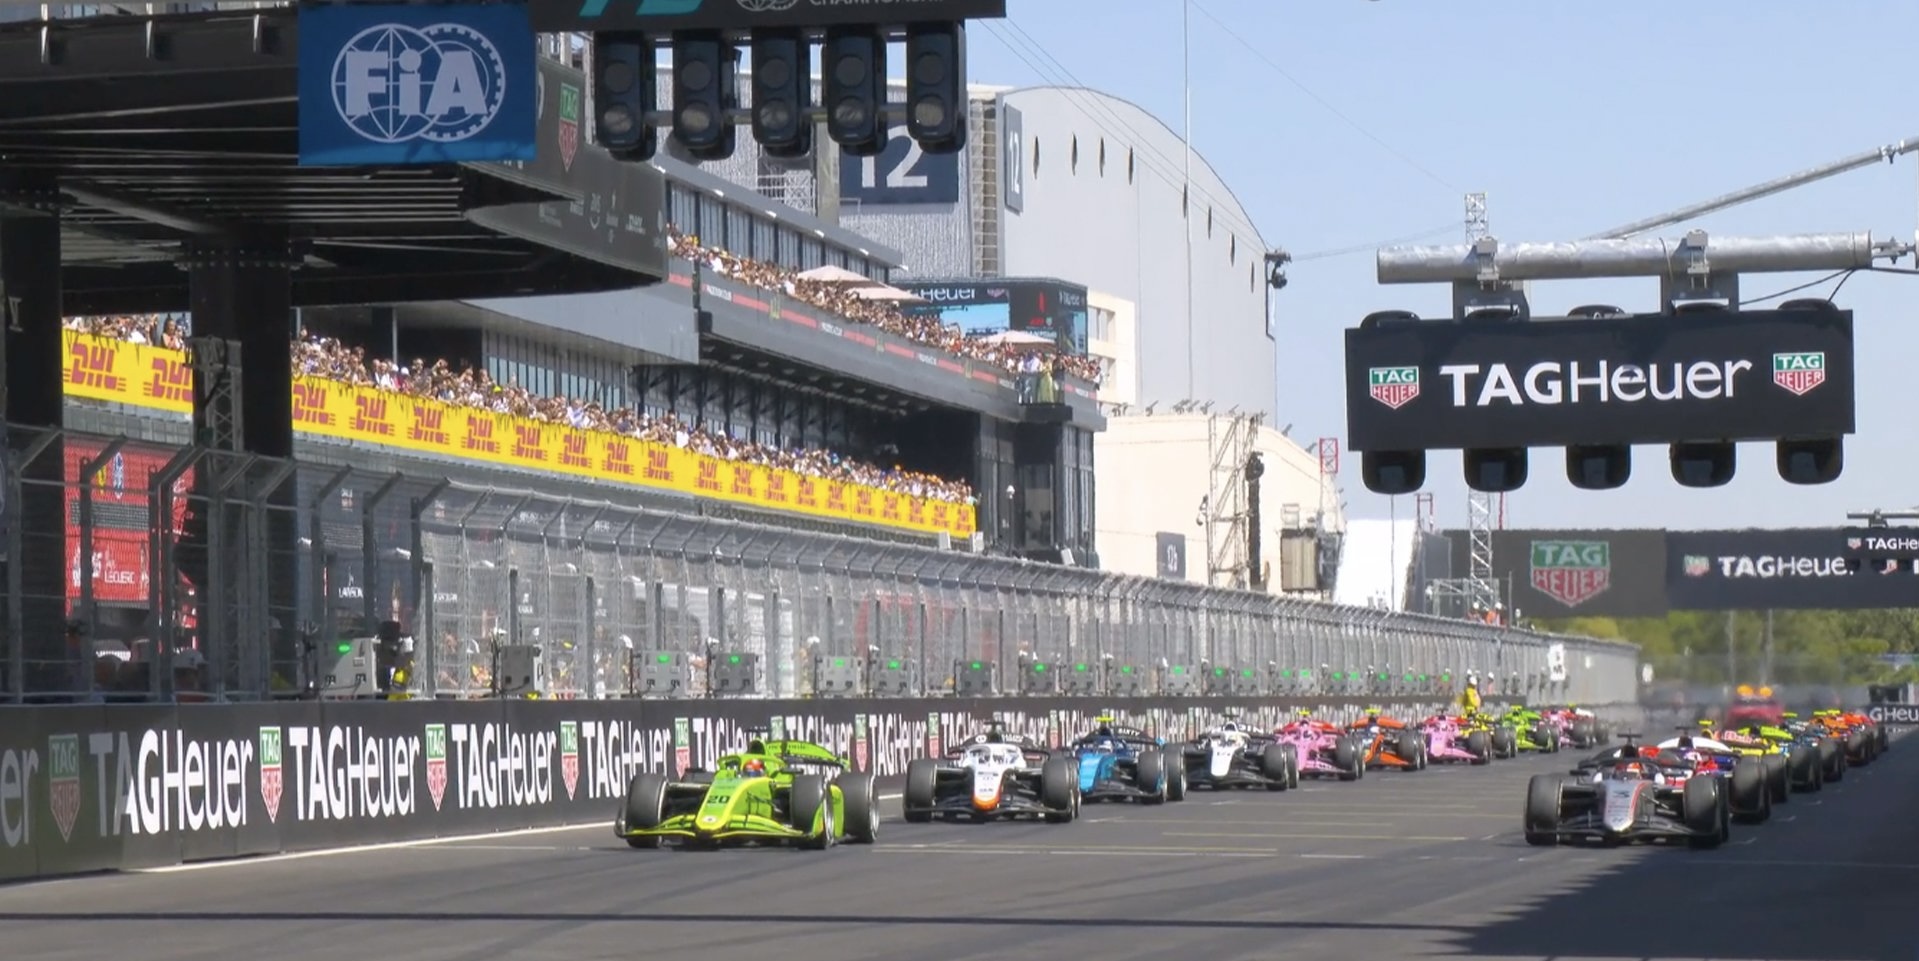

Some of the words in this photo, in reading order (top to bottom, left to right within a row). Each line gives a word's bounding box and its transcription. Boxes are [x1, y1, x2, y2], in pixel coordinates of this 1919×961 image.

[1009, 130, 1020, 195] 12
[71, 343, 118, 389] DHL
[1373, 369, 1415, 383] TAG
[1777, 355, 1820, 369] TAG
[1373, 385, 1416, 405] HEUER
[1440, 360, 1752, 406] TAGHeuer
[1777, 371, 1822, 391] HEUER
[293, 383, 329, 424] DHL
[356, 395, 389, 434] DHL
[413, 405, 444, 444] DHL
[467, 415, 495, 452] DHL
[515, 424, 543, 460] DHL
[563, 434, 588, 468] DHL
[606, 442, 630, 475] DHL
[649, 450, 671, 481] DHL
[1538, 545, 1602, 565] TAG
[1865, 537, 1919, 550] TAGHe
[1535, 570, 1604, 599] HEUER
[52, 742, 77, 774] TAG
[262, 732, 280, 762] TAG
[427, 730, 444, 756] TAG
[289, 725, 420, 820] TAGHeuer
[451, 722, 556, 809] TAGHeuer
[89, 728, 253, 837] TAGHeuer
[707, 795, 730, 803] 20
